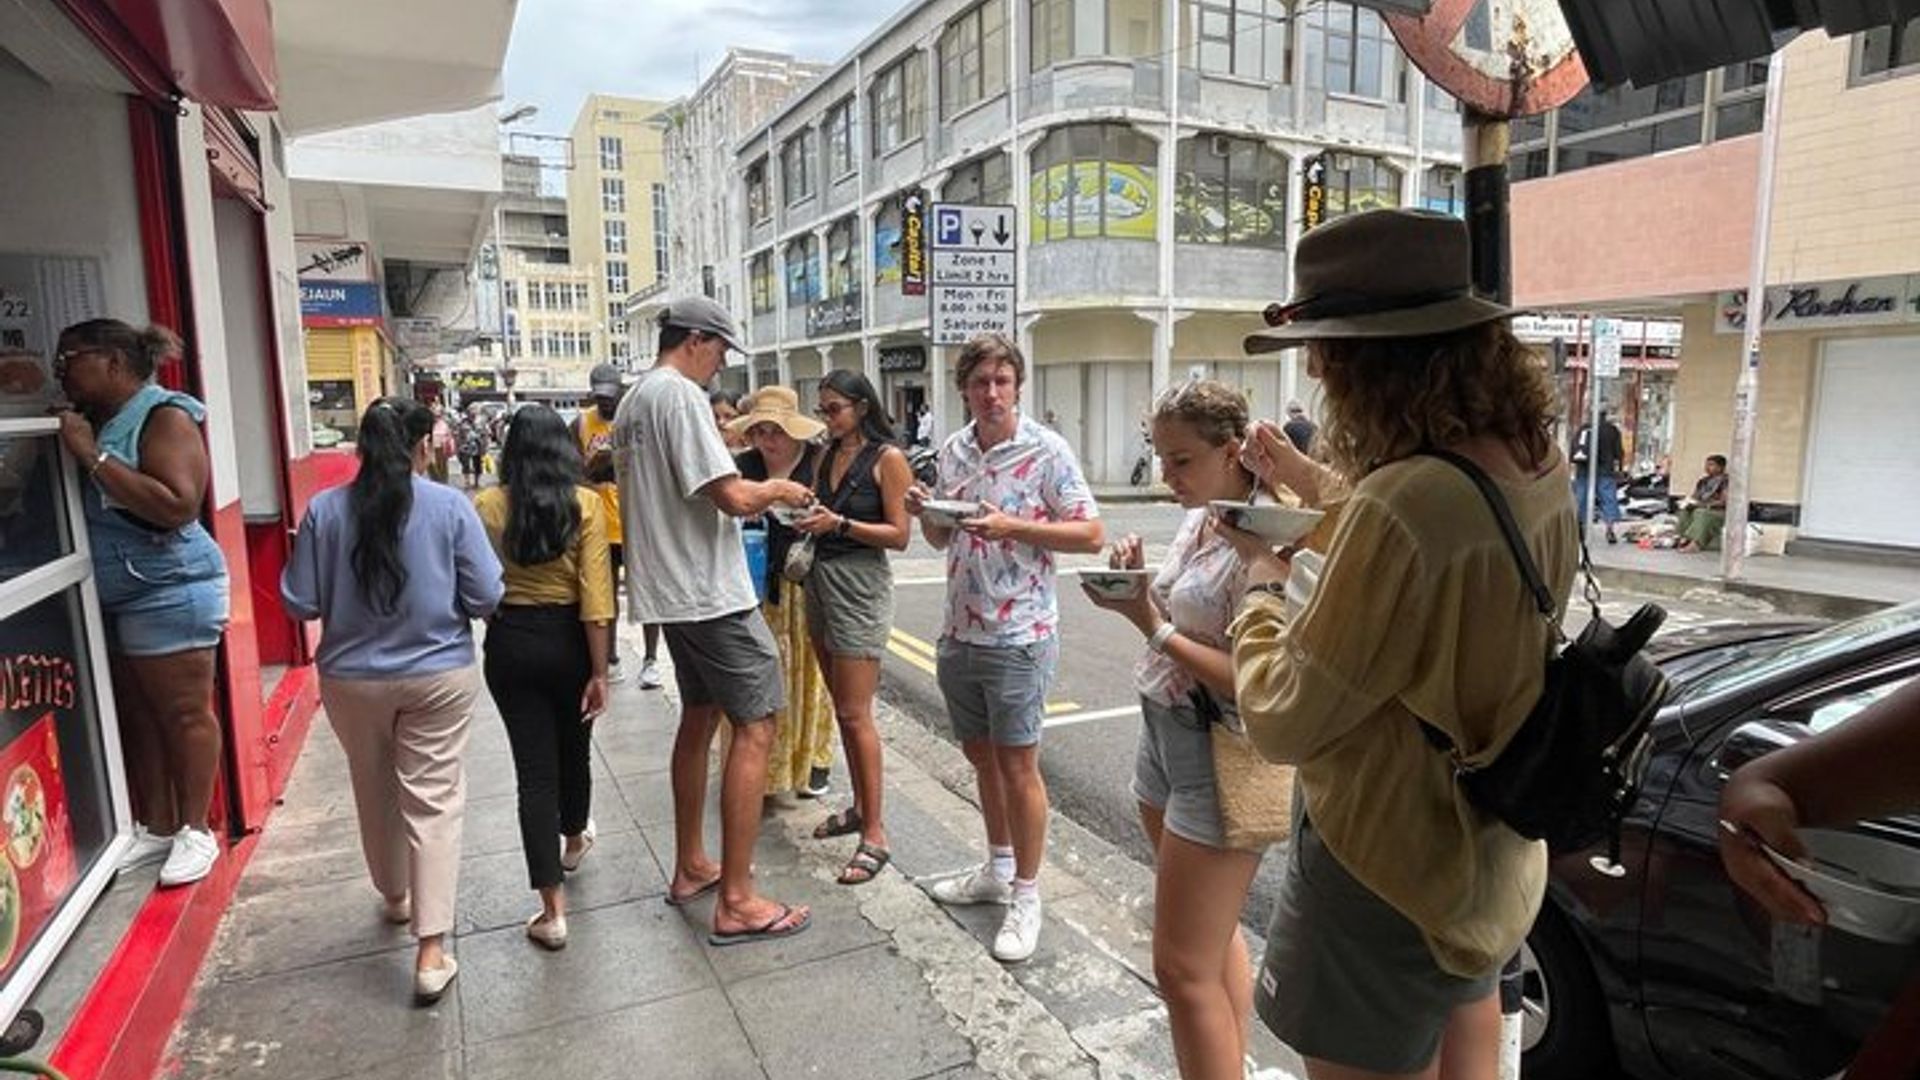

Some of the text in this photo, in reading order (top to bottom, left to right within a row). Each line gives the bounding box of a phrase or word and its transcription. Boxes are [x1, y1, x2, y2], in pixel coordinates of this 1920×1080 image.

[941, 213, 959, 240] P
[952, 253, 997, 267] Zone 1
[976, 270, 984, 281] 2
[943, 289, 974, 300] Mon
[986, 289, 1006, 300] Fri
[943, 318, 1005, 331] Saturday
